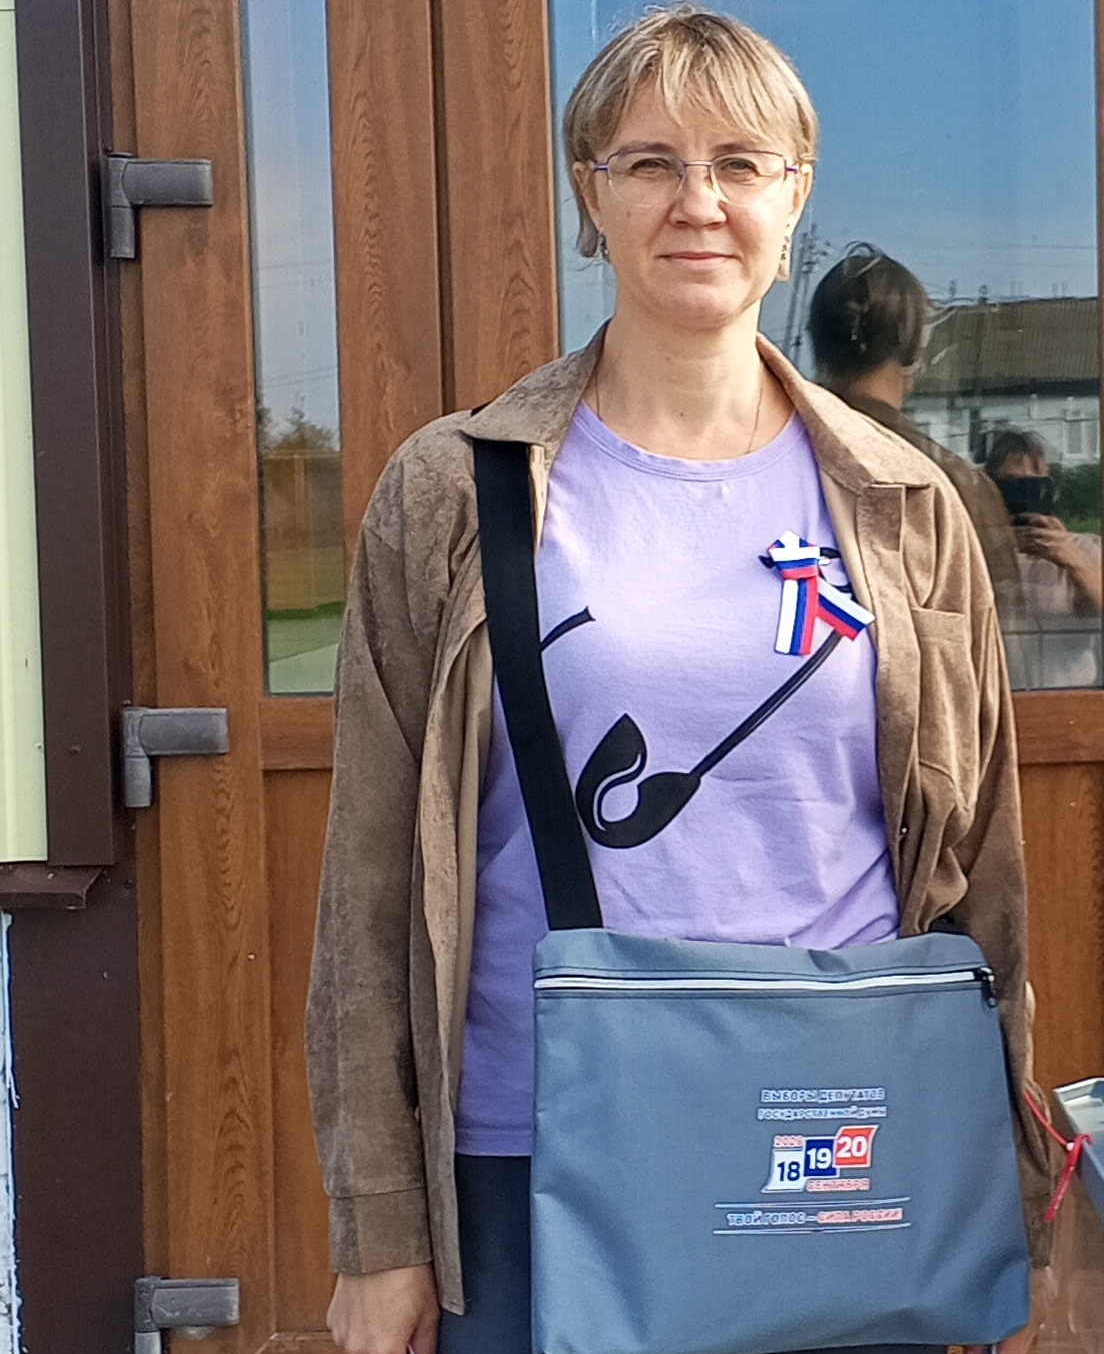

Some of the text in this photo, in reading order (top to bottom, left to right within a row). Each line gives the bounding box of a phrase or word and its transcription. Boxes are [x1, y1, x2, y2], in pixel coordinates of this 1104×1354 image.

[777, 1135, 868, 1182] 18 19 20
